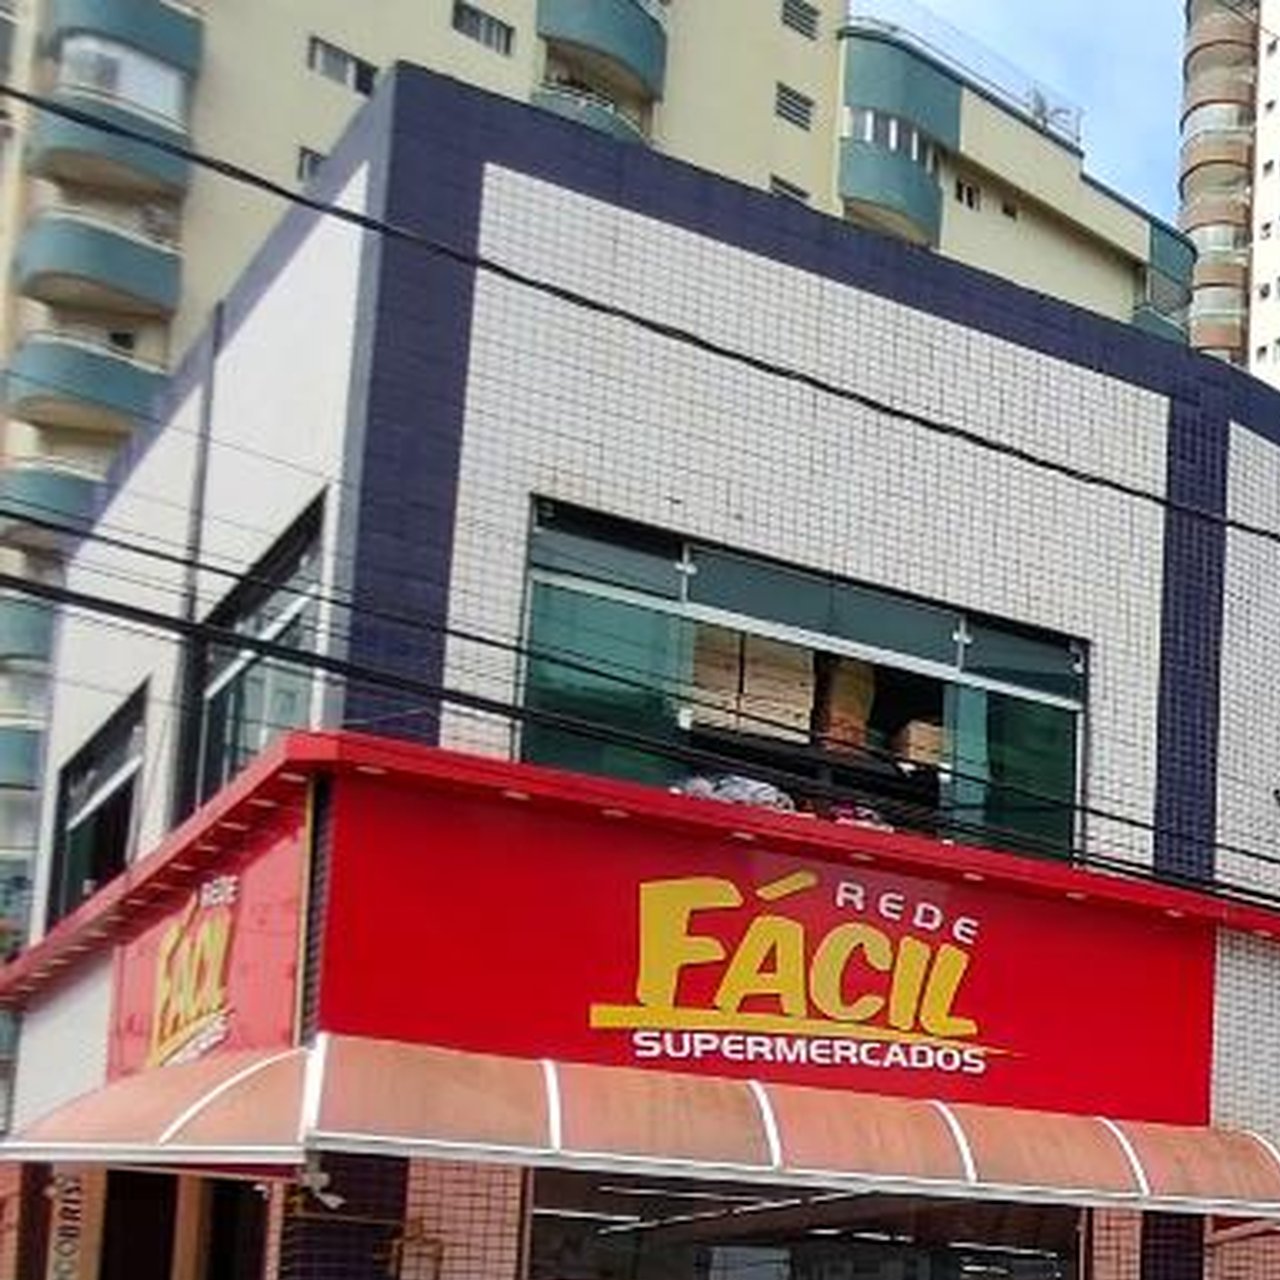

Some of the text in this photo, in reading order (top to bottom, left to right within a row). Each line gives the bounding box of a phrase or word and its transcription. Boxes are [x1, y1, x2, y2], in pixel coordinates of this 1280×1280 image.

[834, 881, 980, 945] REDE
[636, 870, 978, 1037] FÁCIL
[632, 1030, 986, 1074] SUPERMERCADOS
